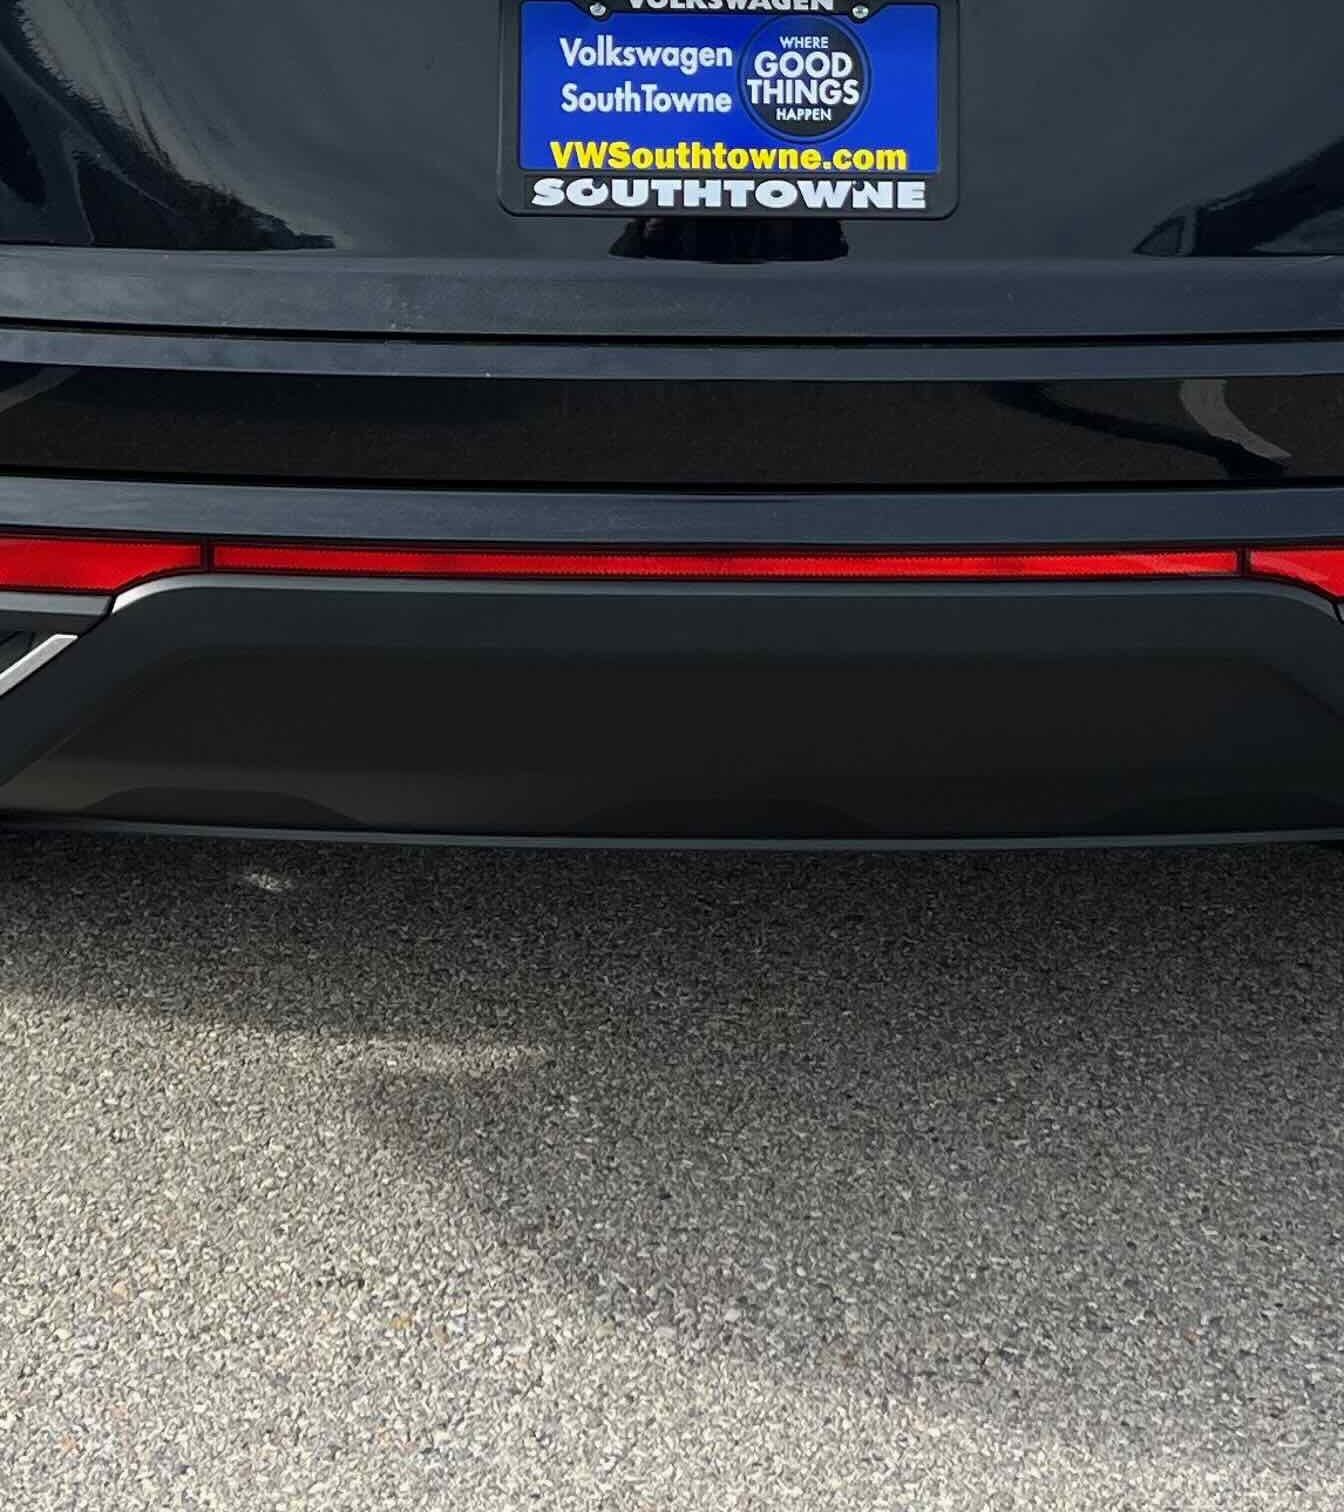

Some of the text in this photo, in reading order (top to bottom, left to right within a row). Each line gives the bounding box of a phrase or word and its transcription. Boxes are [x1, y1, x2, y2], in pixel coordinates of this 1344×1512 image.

[559, 34, 734, 74] Volkswagen
[779, 35, 829, 49] WHERE
[753, 50, 853, 78] GOOD
[560, 80, 733, 113] SouthTowne
[746, 78, 860, 106] THINGS
[775, 107, 832, 121] HAPPEN
[549, 141, 909, 171] VWSouthtowne.com
[530, 176, 928, 210] SOUTHTOWNE
